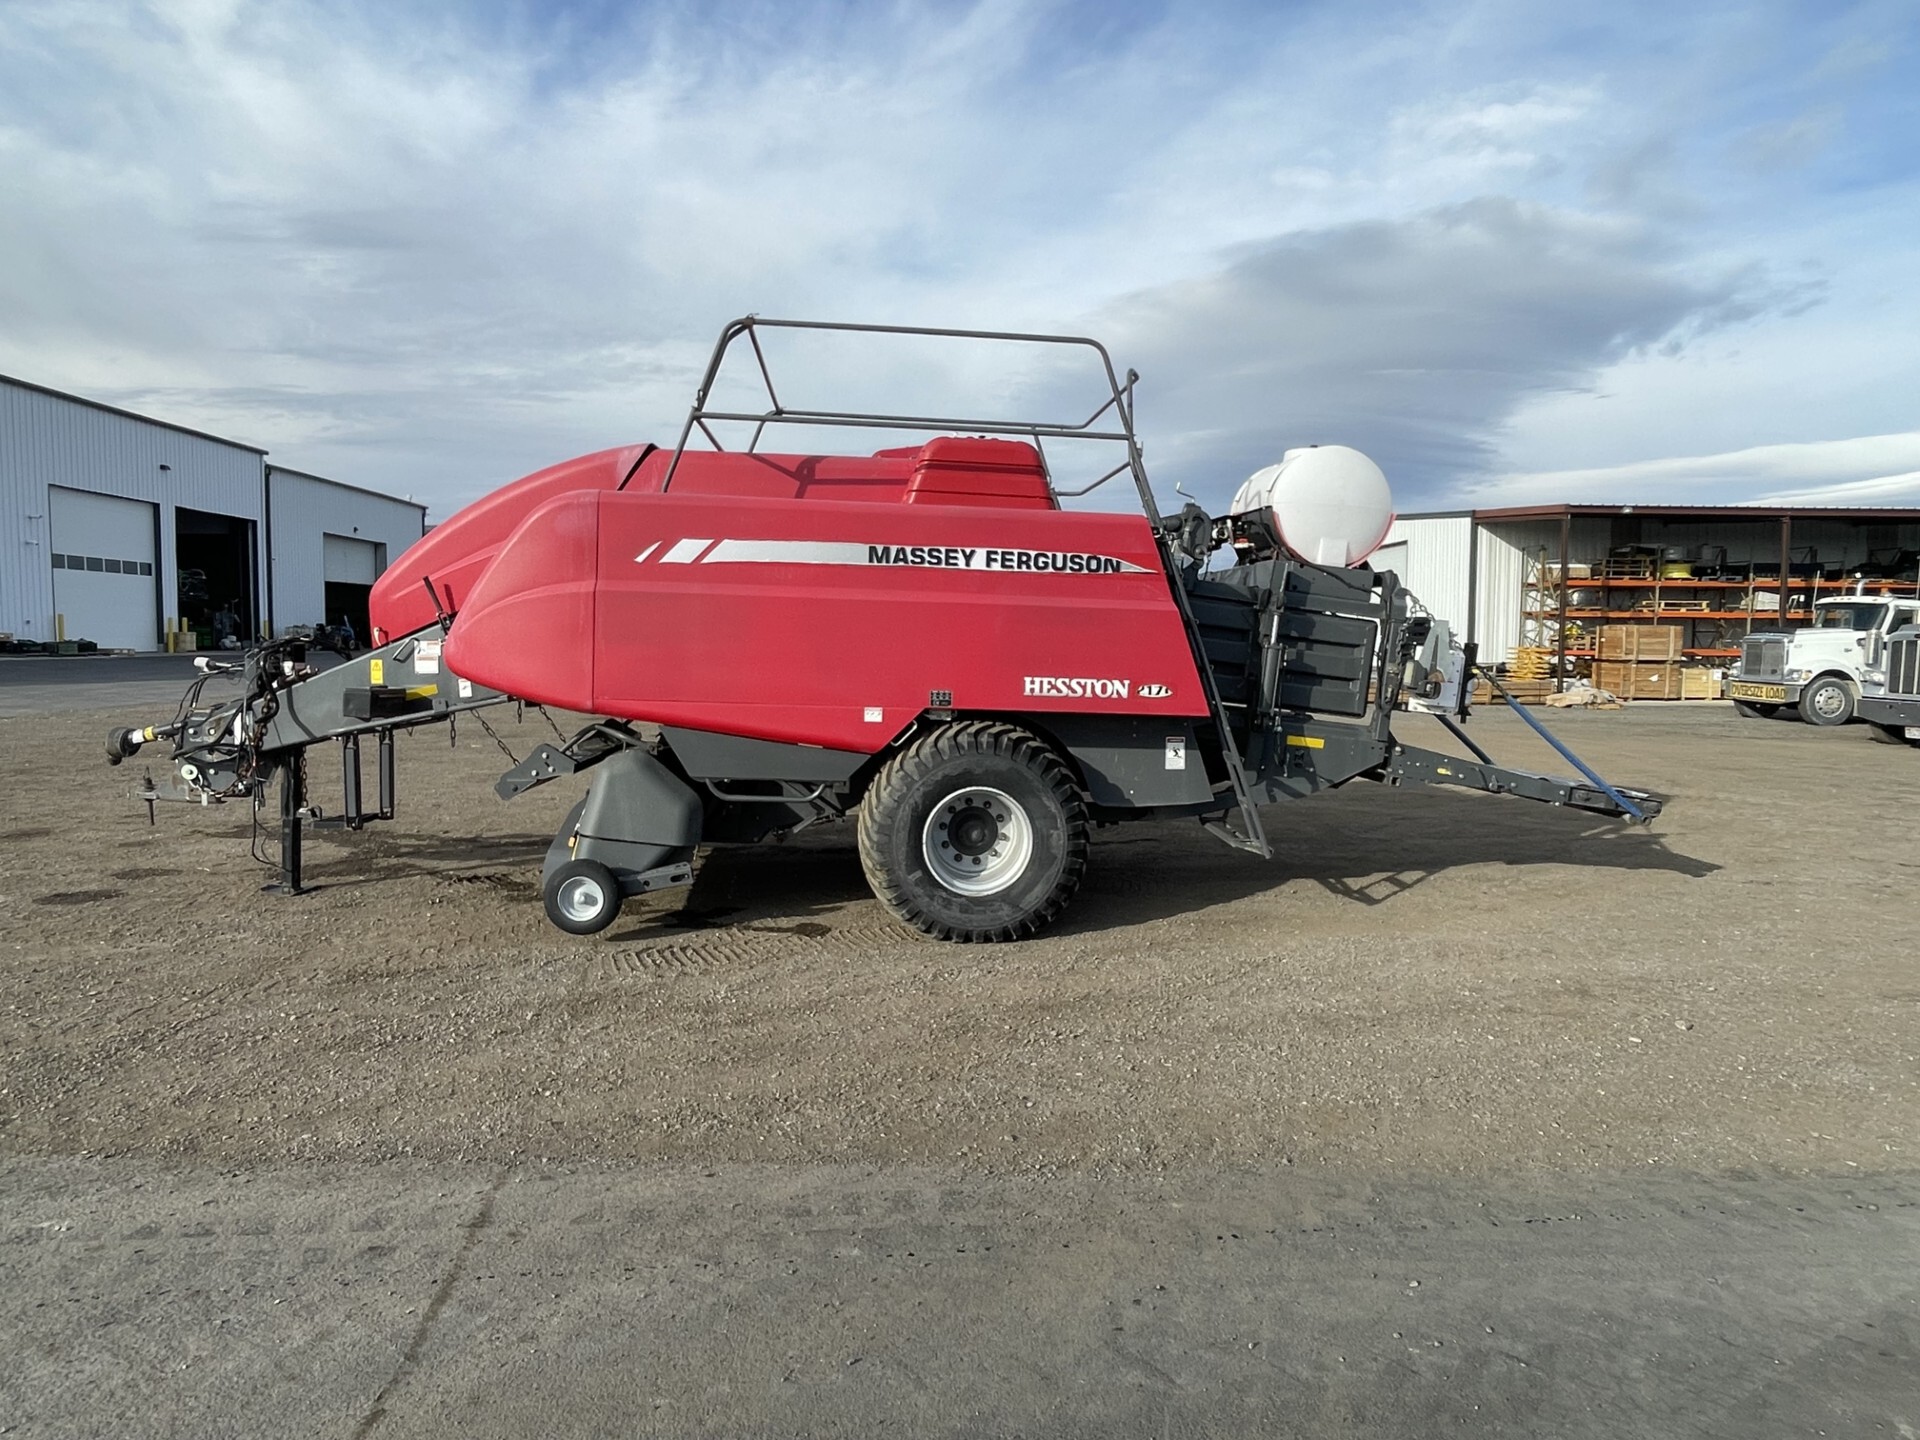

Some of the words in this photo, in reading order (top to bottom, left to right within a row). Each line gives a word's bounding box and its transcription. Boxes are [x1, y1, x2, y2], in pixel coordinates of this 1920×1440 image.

[868, 546, 977, 568] MASSEY
[985, 550, 1121, 574] FERGUSON
[1023, 676, 1130, 699] HESSTON
[1765, 687, 1786, 700] LOAD
